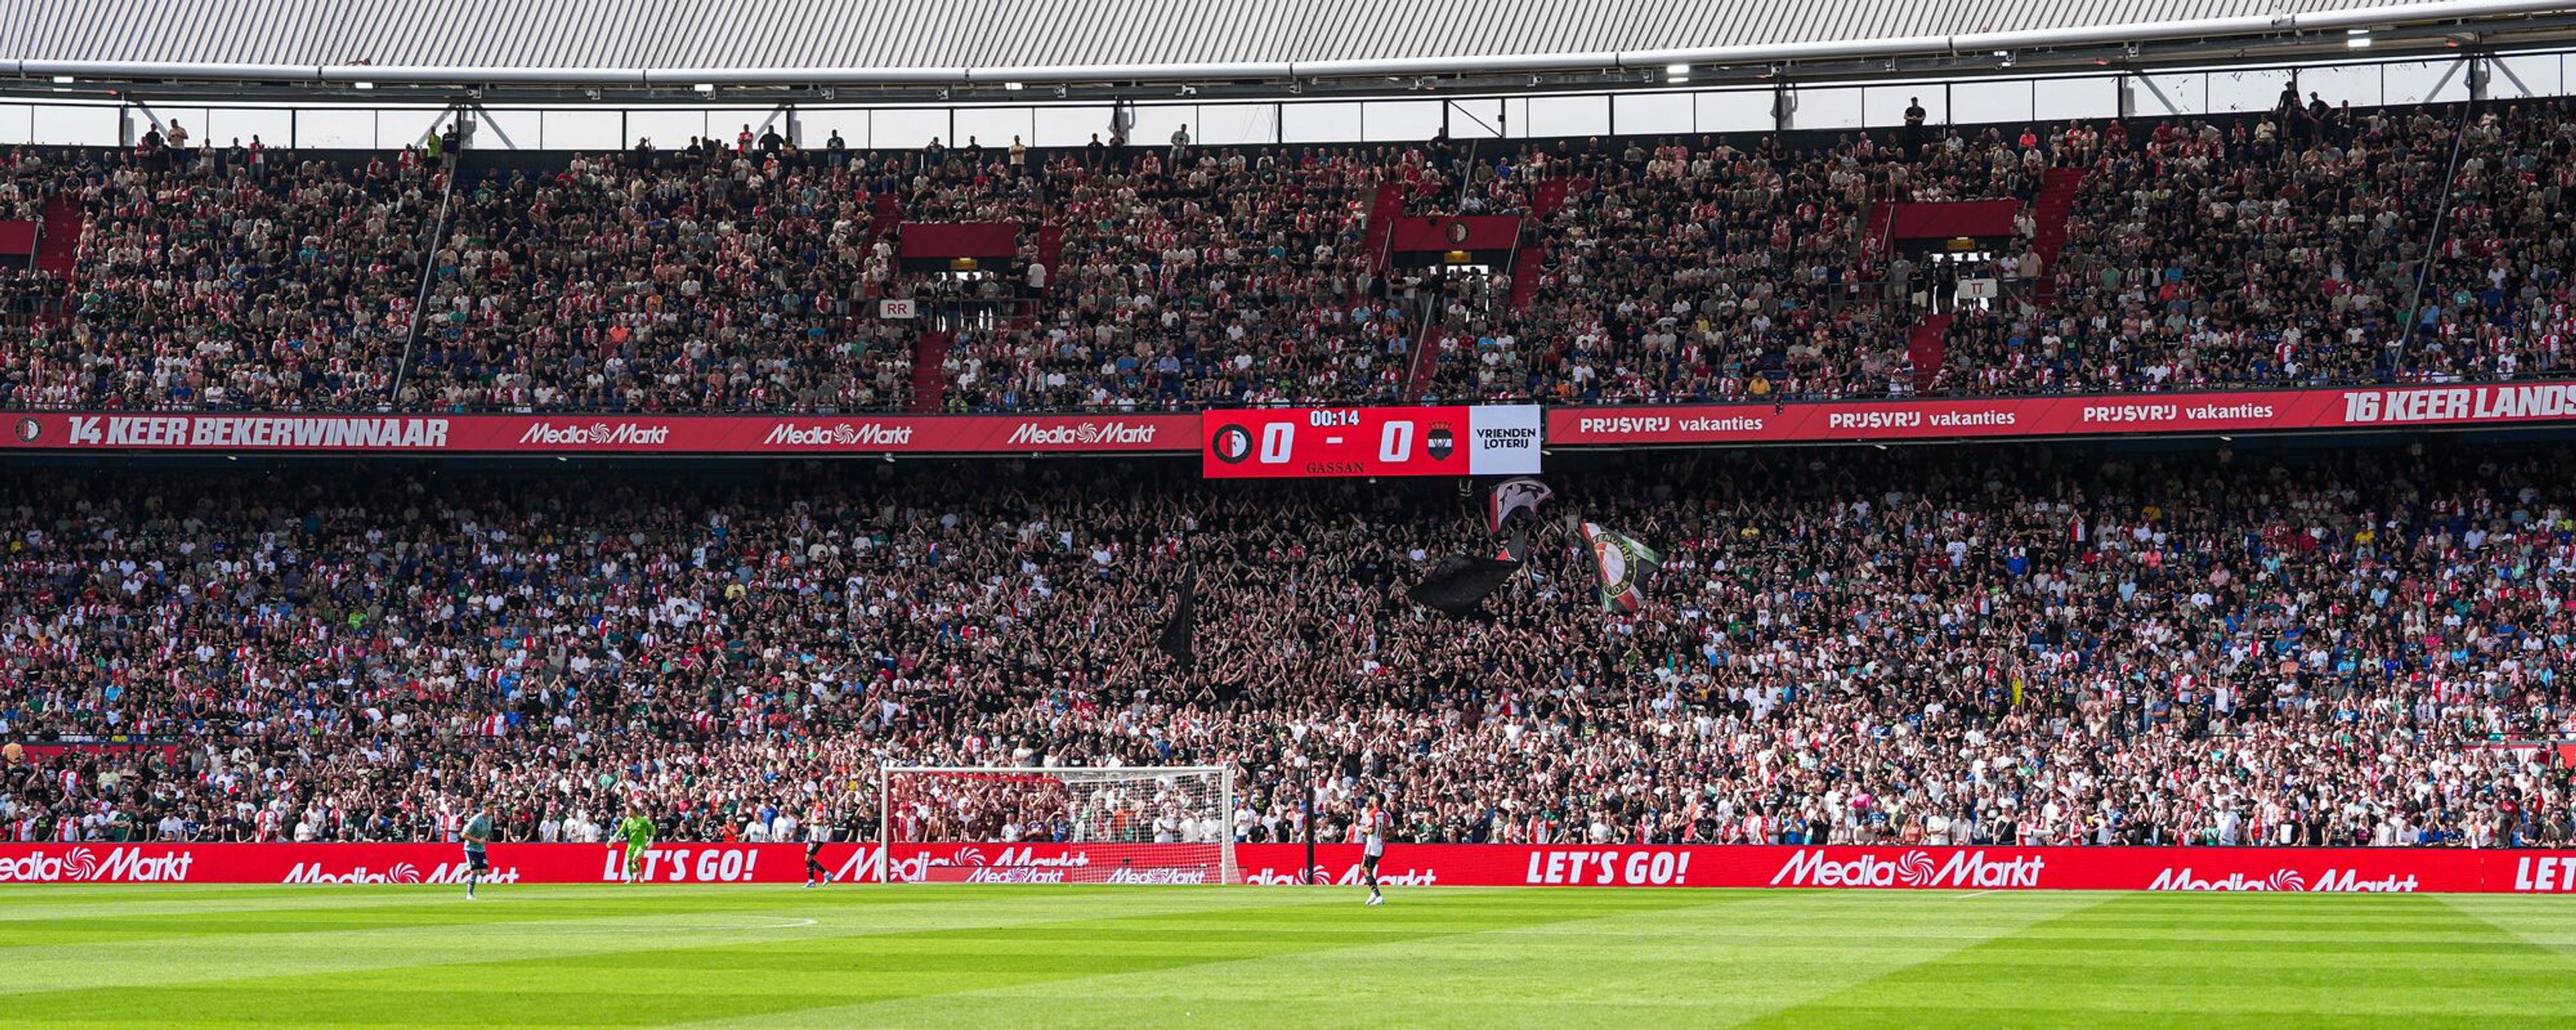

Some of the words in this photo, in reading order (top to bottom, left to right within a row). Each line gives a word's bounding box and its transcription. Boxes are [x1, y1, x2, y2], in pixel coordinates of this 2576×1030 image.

[887, 303, 908, 315] RR
[2186, 402, 2273, 419] vakanties
[2343, 392, 2381, 422] 16
[2382, 388, 2471, 421] KEER
[1310, 410, 1360, 426] 00:14
[1678, 416, 1763, 431] vakanties
[1929, 410, 2015, 426] vakanties
[68, 416, 102, 445] 14
[105, 416, 189, 445] KEER
[191, 417, 449, 447] BEKERWINNAAR
[519, 422, 588, 444] Media
[606, 423, 669, 444] Markt
[763, 423, 833, 445] Media
[851, 423, 913, 445] Markt
[1007, 422, 1075, 444] Media
[1093, 422, 1156, 443] Markt
[1260, 422, 1295, 463] 0
[1379, 421, 1414, 462] 0
[1477, 428, 1536, 439] VRIENDEN
[1485, 439, 1529, 450] LOTERIJ
[1306, 462, 1364, 473] GASSAN
[91, 847, 193, 880] Markt
[425, 862, 520, 884] Mkt
[696, 849, 759, 881] GO!
[832, 847, 949, 881] Mdi
[1526, 851, 1616, 884] LET'S
[1625, 851, 1690, 884] GO!
[1770, 850, 1894, 886] Media
[1929, 850, 2045, 886] Markt
